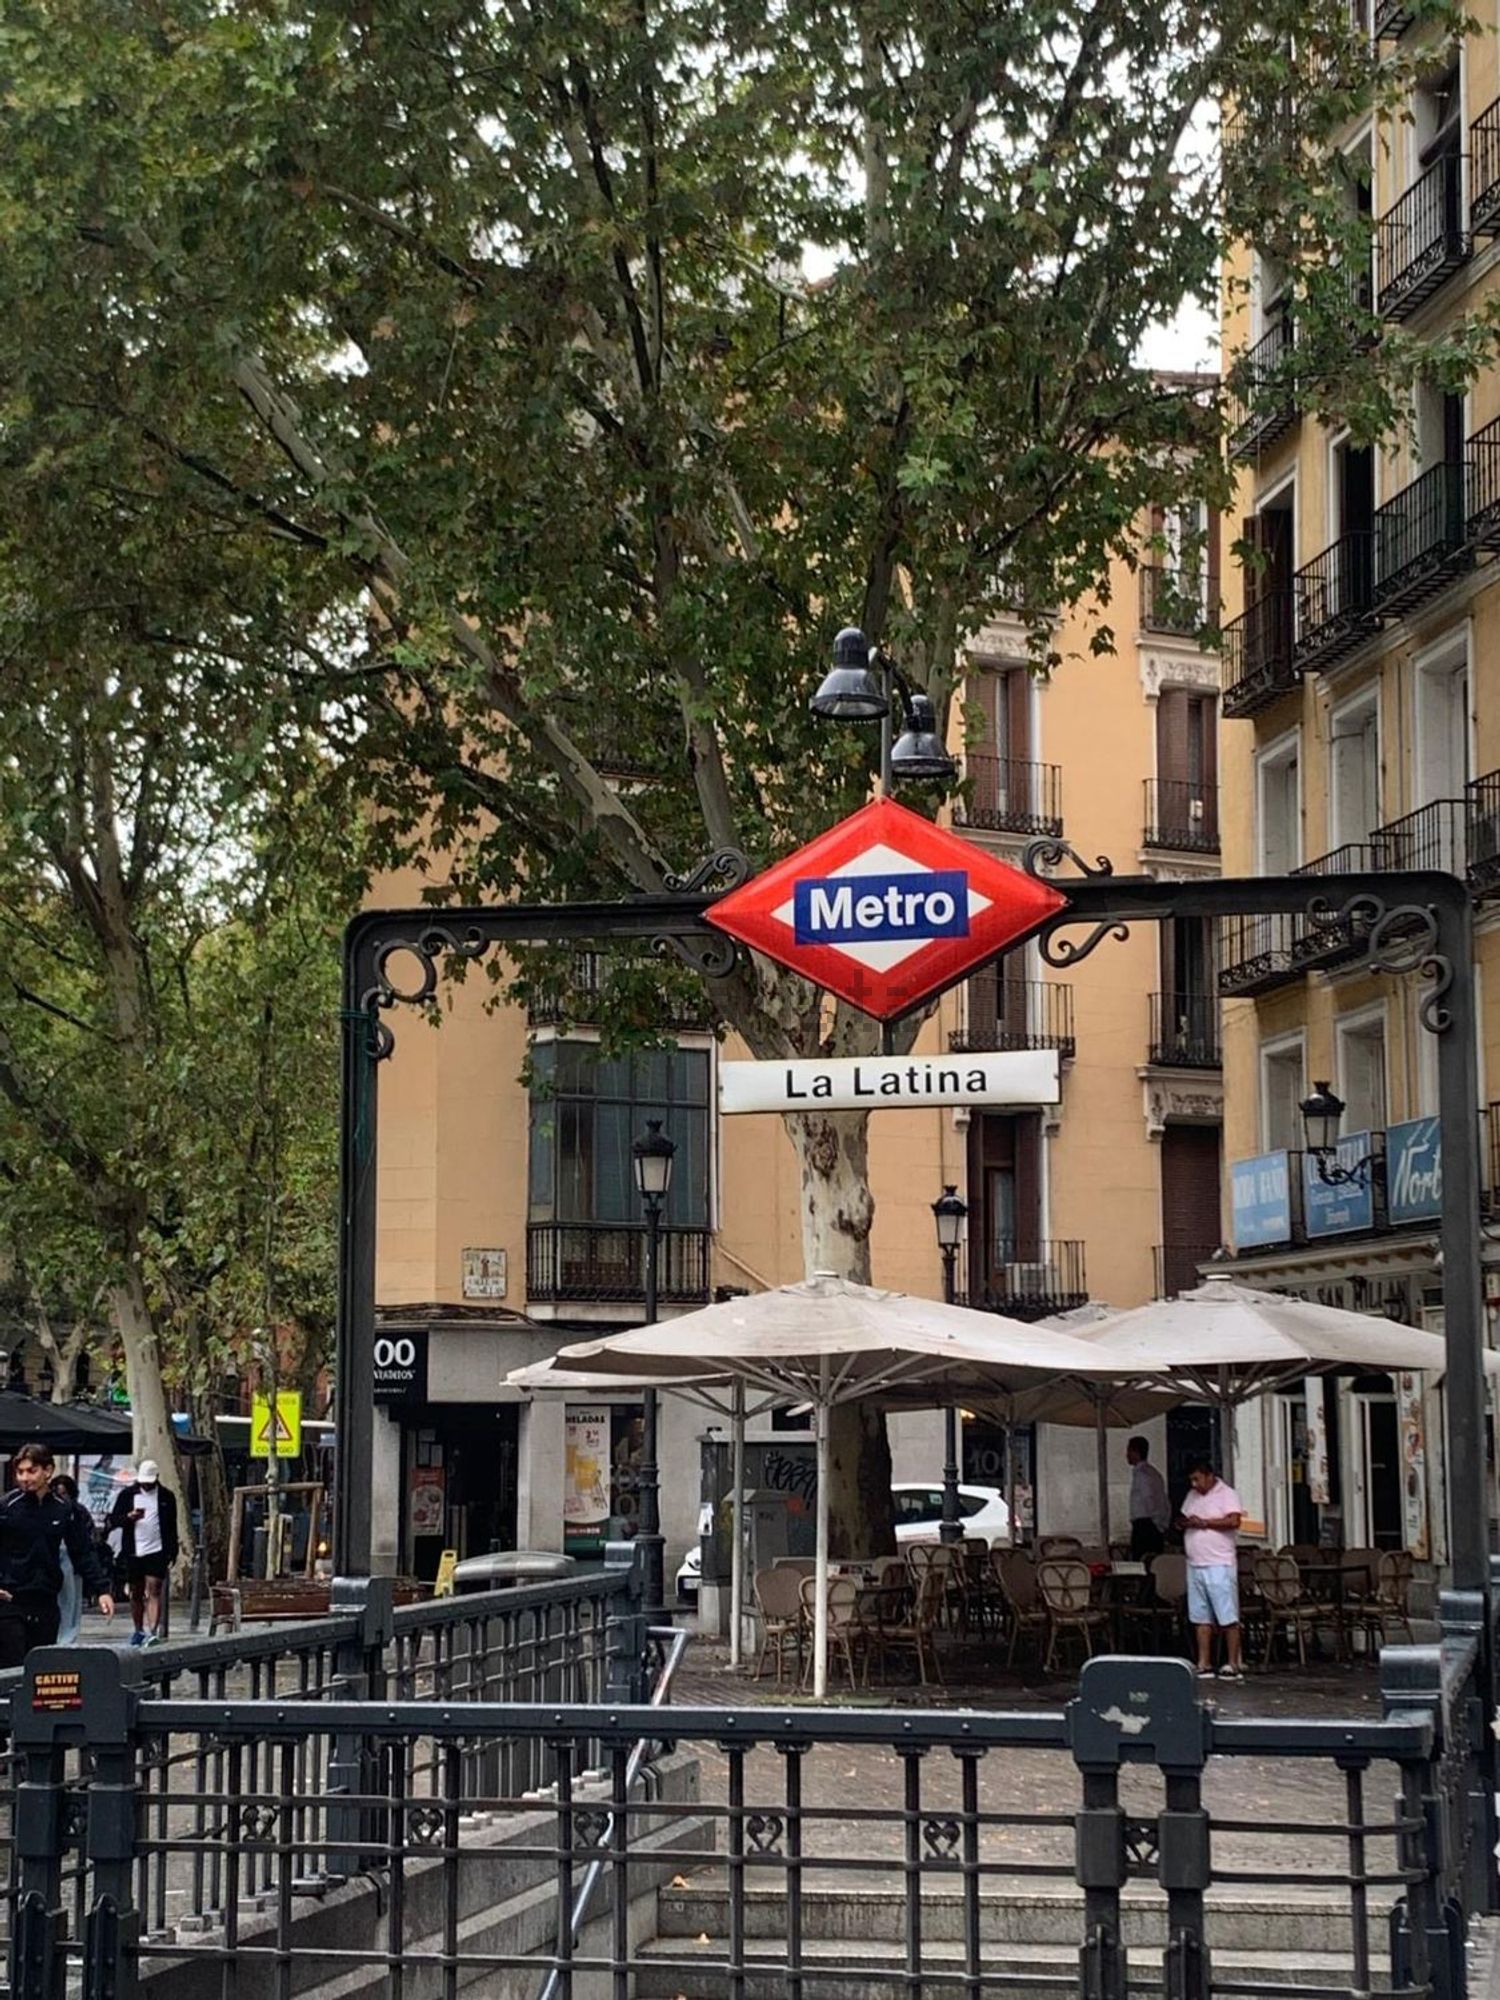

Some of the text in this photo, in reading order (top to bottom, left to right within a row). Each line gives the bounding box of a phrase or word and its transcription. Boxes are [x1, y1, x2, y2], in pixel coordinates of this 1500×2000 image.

[810, 885, 955, 931] Metro
[786, 1065, 988, 1099] La Latina
